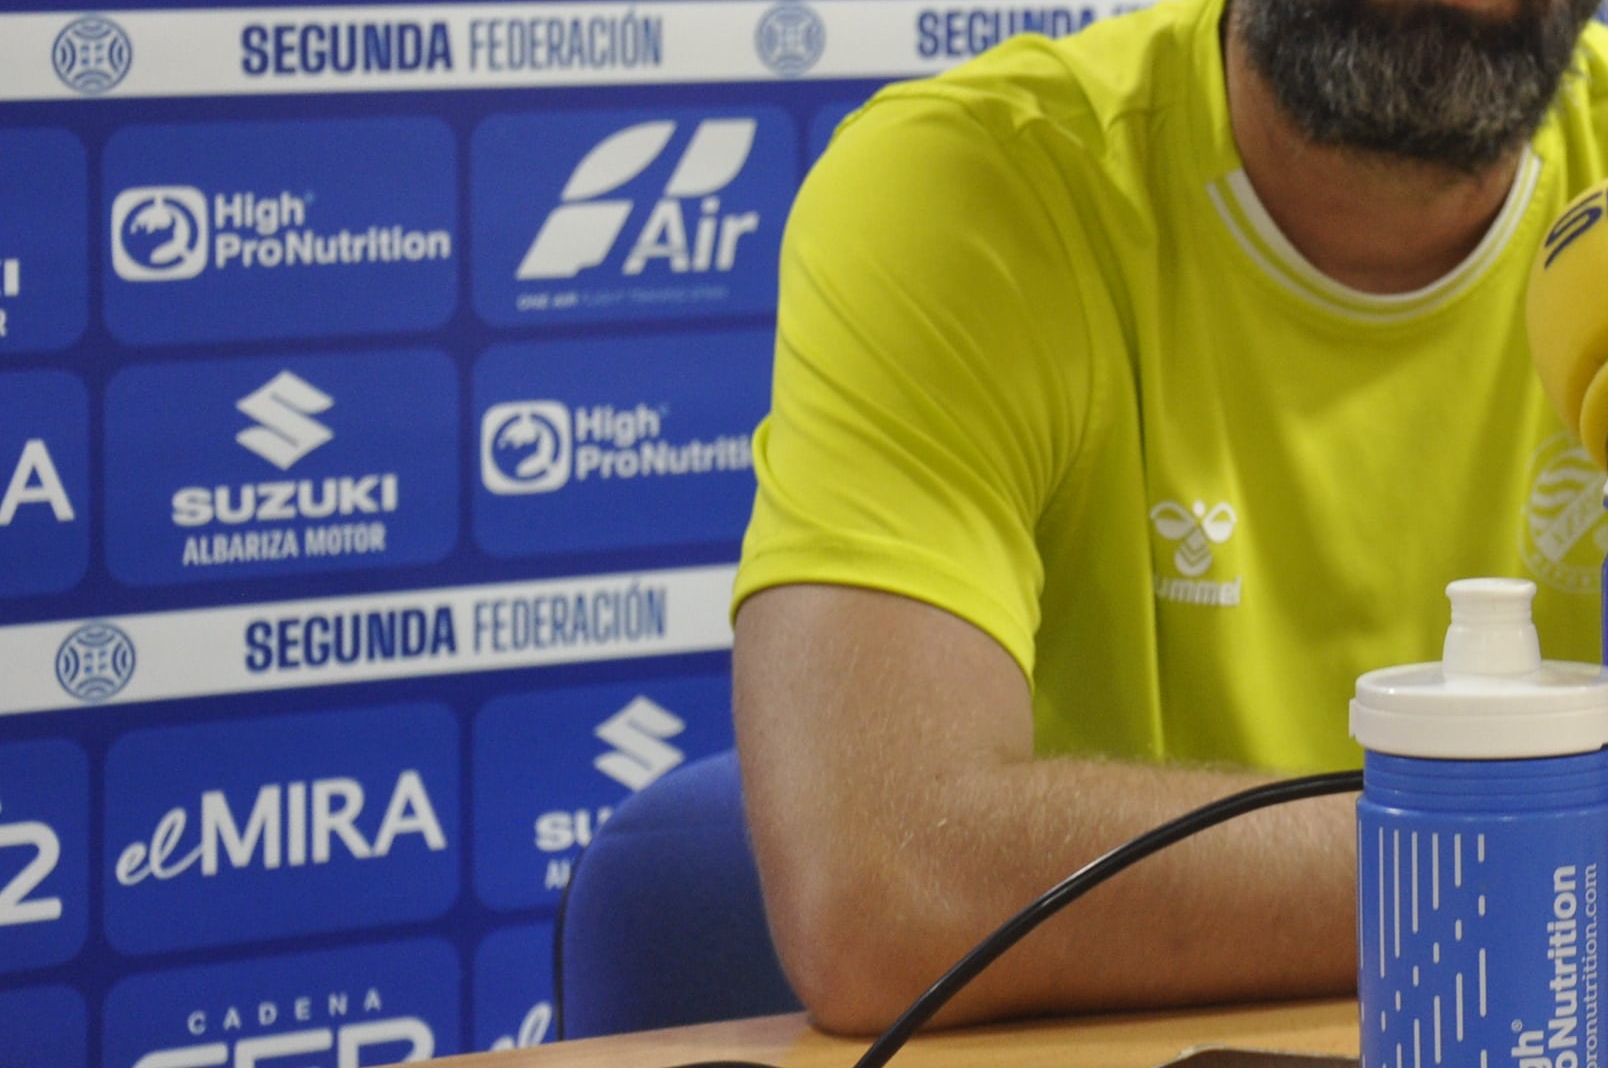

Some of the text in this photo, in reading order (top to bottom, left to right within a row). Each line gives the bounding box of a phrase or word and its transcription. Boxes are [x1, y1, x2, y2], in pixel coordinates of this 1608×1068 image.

[241, 7, 663, 78] SEGUNDA FEDERACIÓN
[215, 227, 450, 270] ProNutrition
[622, 199, 760, 276] Air
[574, 436, 756, 480] ProNutriti
[171, 474, 398, 527] SUZUKI
[183, 522, 385, 568] ALBARIZA MOTOR
[245, 585, 666, 672] SEGUNDA FEDERACIÓN
[187, 988, 382, 1034] CADENA
